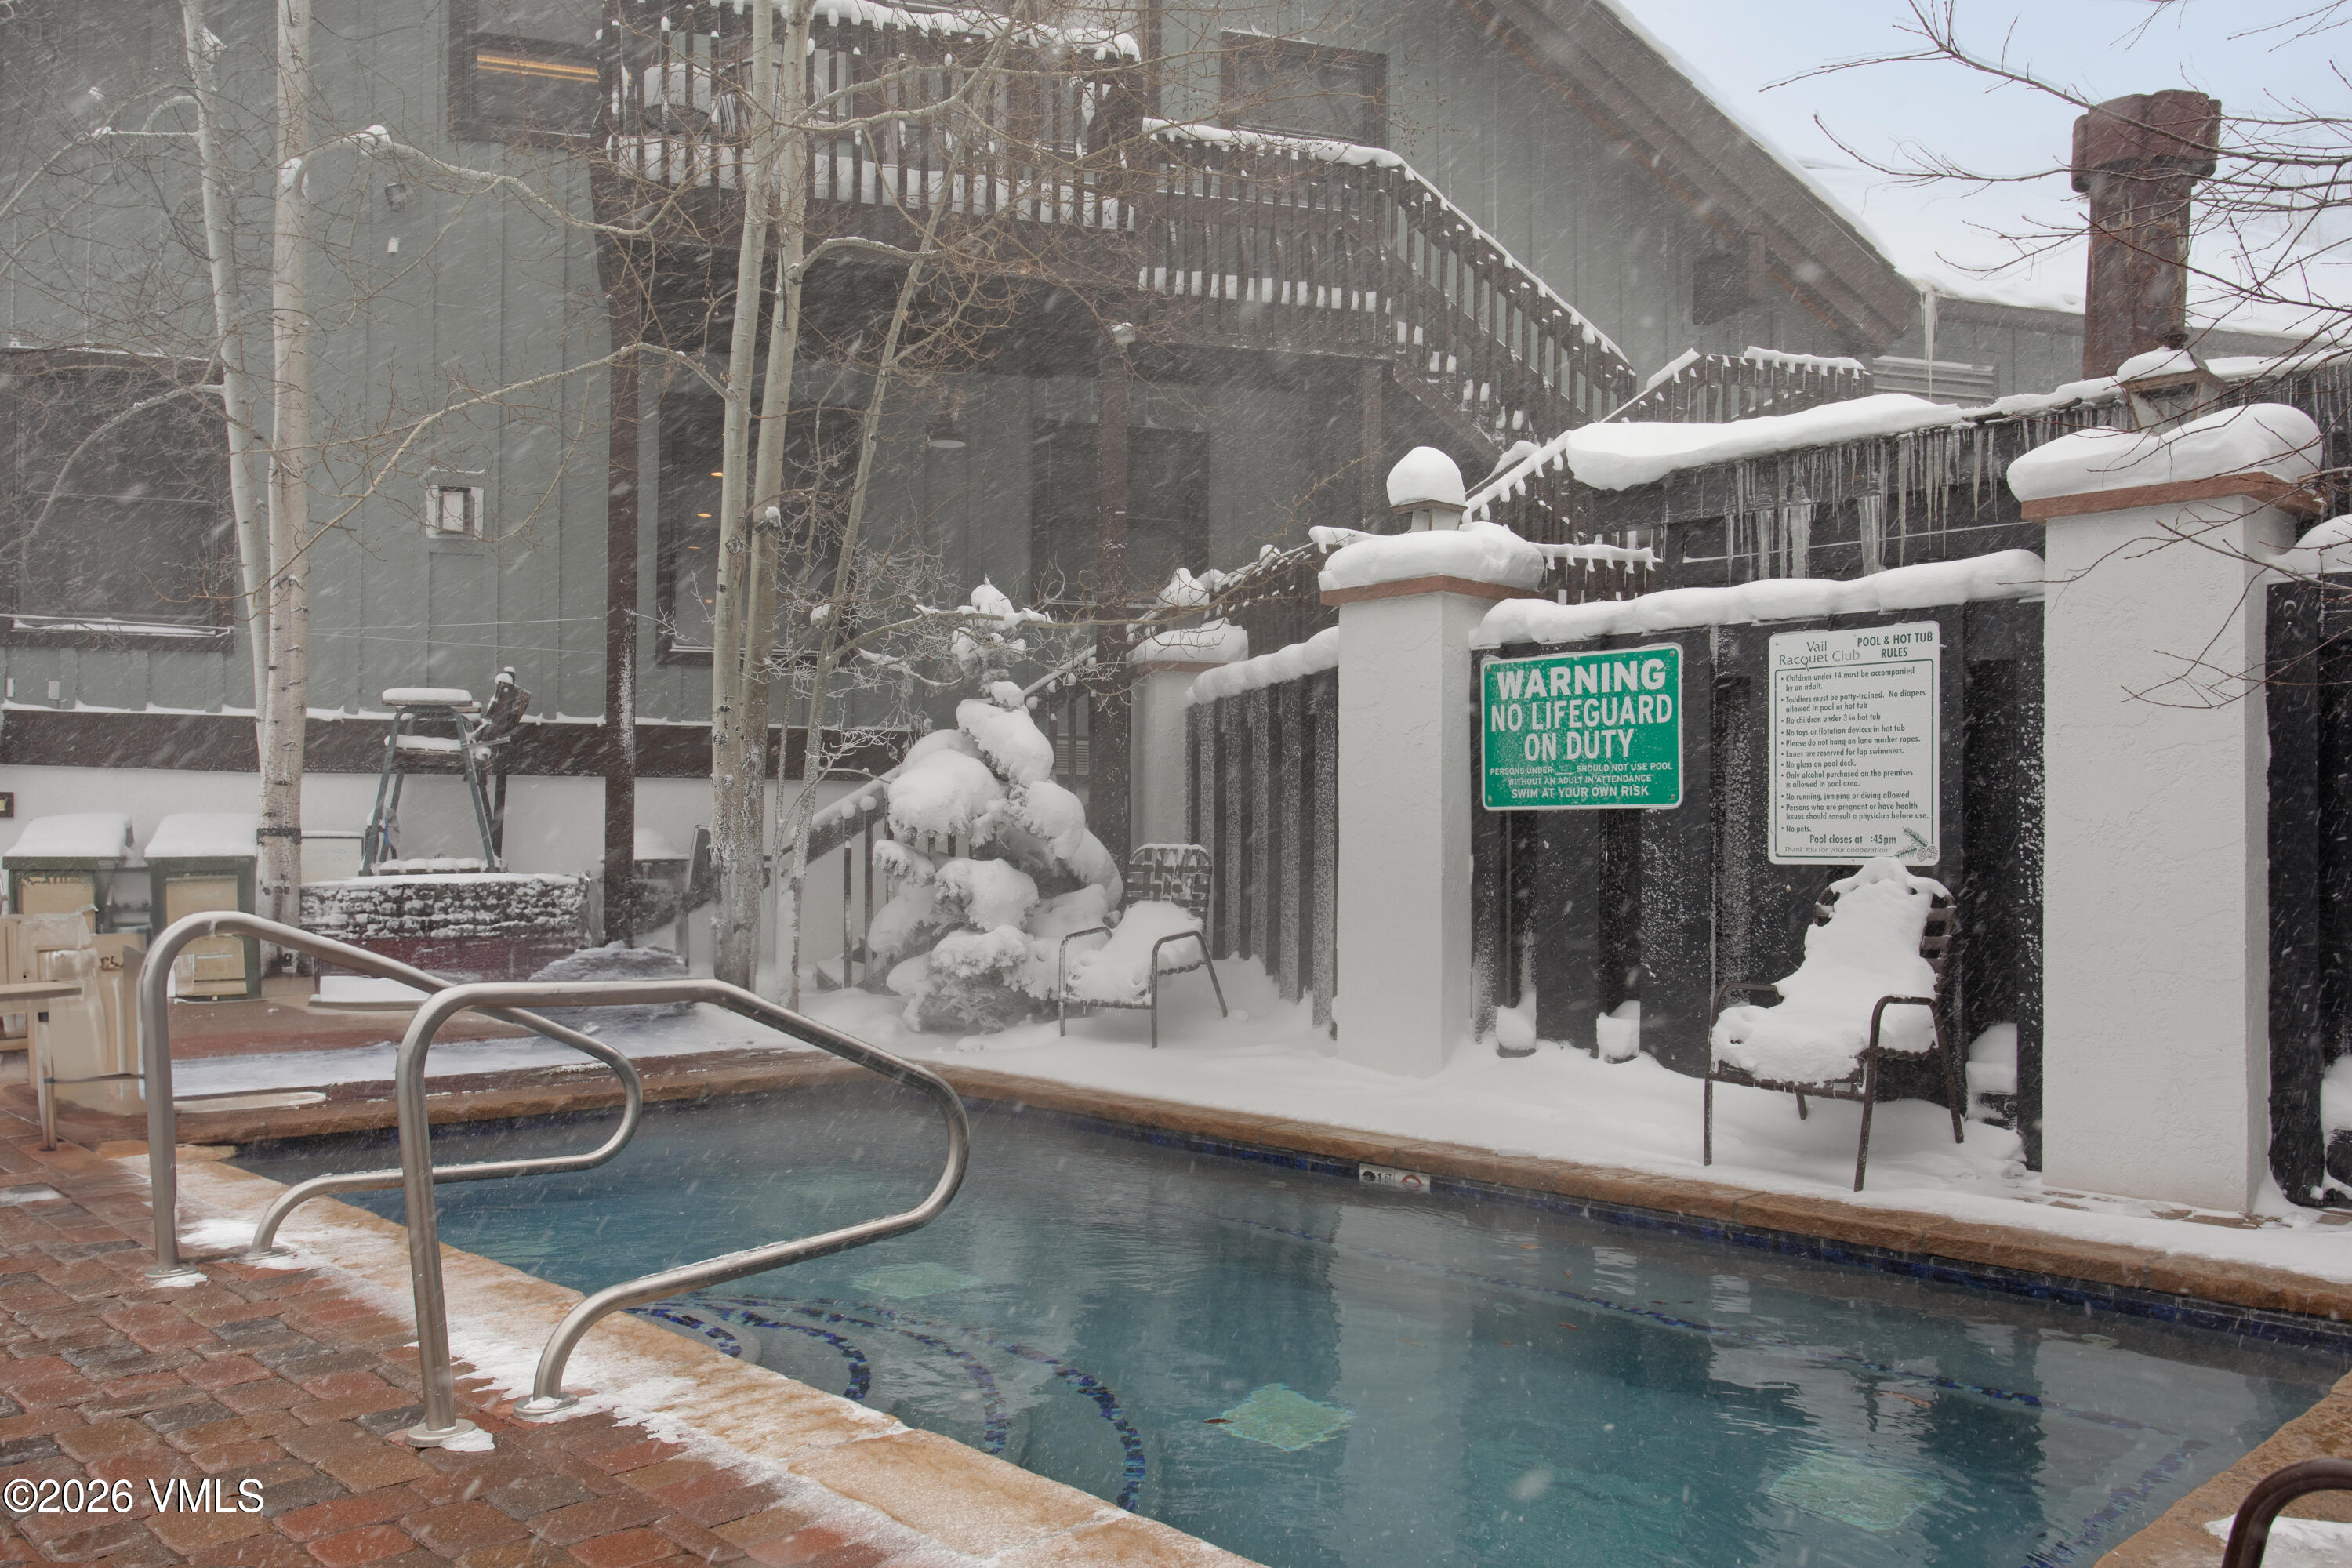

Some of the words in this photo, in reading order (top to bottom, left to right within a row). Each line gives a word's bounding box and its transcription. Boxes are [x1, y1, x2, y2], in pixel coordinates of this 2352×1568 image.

[1857, 637, 1881, 647] POOL
[1893, 633, 1911, 644] HOT
[1915, 632, 1933, 642] TUB
[1806, 641, 1827, 652] Vail
[1882, 648, 1907, 658] RULES
[1779, 653, 1828, 671] Racquet
[1832, 649, 1860, 662] Club
[1871, 667, 1915, 679] accompanied
[1497, 659, 1666, 700] WARNING
[1900, 689, 1926, 699] diapers
[1491, 704, 1522, 732] NO
[1532, 694, 1672, 730] LIFEGUARD
[1820, 703, 1834, 713] pool
[1797, 715, 1821, 724] children
[1796, 728, 1809, 737] toys
[1819, 726, 1846, 735] flotation
[1524, 733, 1556, 761] ON
[1568, 729, 1634, 760] DUTY
[1830, 737, 1846, 746] hang
[1857, 747, 1867, 757] lap
[1797, 760, 1812, 769] glass
[1824, 759, 1838, 768] pool
[1786, 771, 1800, 779] Only
[1802, 770, 1824, 779] alcohol
[1826, 769, 1858, 779] purchased
[1883, 768, 1913, 778] premises
[1595, 775, 1651, 783] ATTENDANCE
[1793, 779, 1817, 788] allowed
[1827, 779, 1841, 788] pool
[1512, 789, 1537, 798] SWIM
[1542, 788, 1554, 797] AT
[1559, 788, 1588, 797] YOUR
[1592, 787, 1617, 796] OWN
[1621, 786, 1649, 796] RISK
[1824, 792, 1850, 801] jumping
[1860, 791, 1881, 800] diving
[1811, 802, 1824, 811] who
[1838, 803, 1867, 811] pregnant
[1806, 811, 1827, 820] should
[1859, 811, 1889, 821] physician
[1891, 810, 1913, 818] before
[1796, 825, 1811, 833] pets.
[1809, 834, 1826, 844] Pool
[1829, 833, 1852, 844] closes
[1854, 835, 1862, 844] at
[1847, 846, 1890, 855] cooperation!
